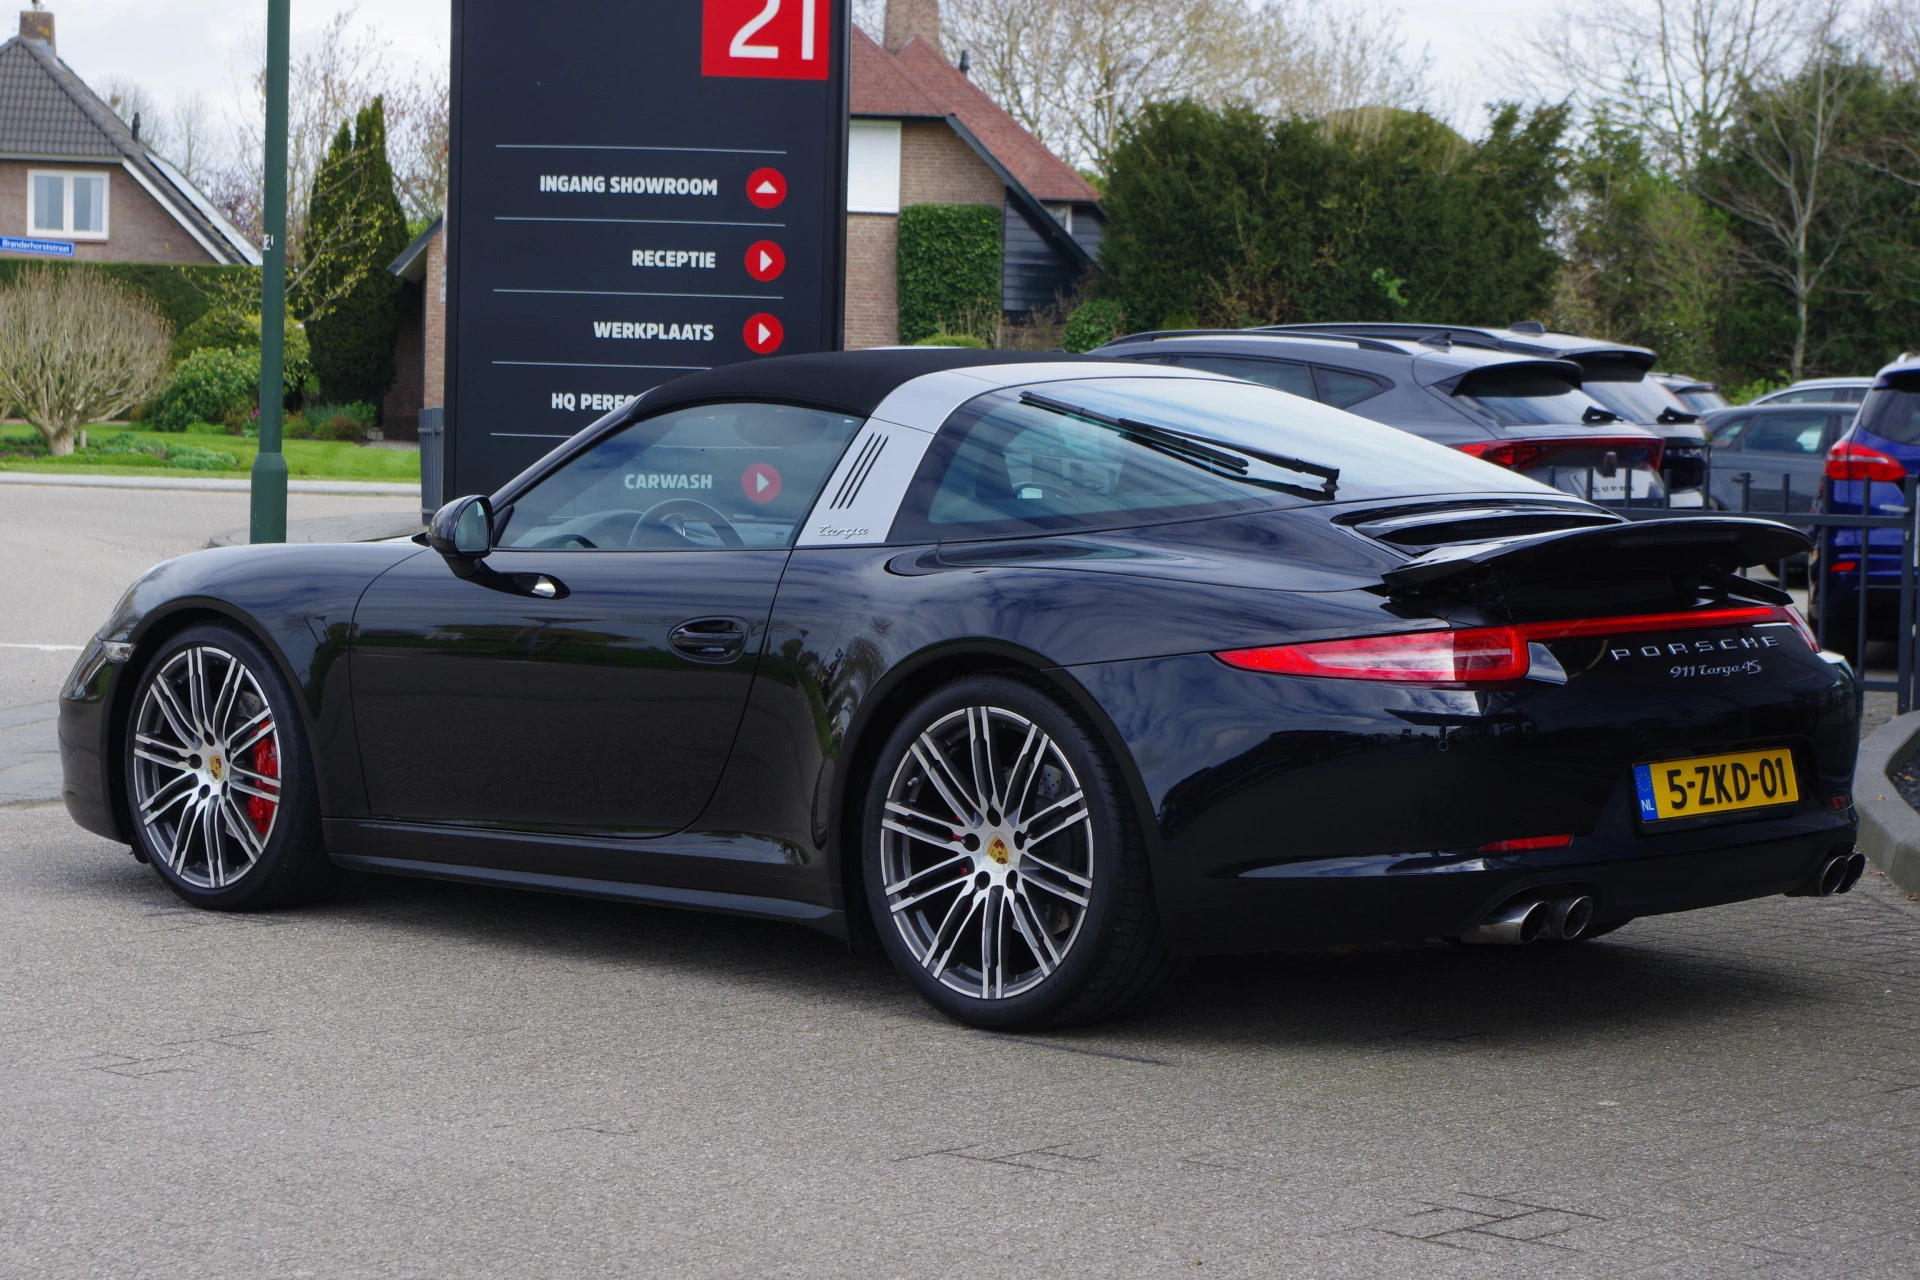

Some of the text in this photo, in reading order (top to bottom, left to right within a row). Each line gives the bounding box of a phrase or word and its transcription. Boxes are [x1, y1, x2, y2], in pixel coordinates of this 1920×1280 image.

[729, 0, 816, 61] 21
[539, 175, 718, 196] INGANG SHOWROOM
[631, 249, 716, 269] RECEPTIE
[593, 321, 714, 341] WERKPLAATS
[551, 392, 576, 412] HQ
[624, 473, 713, 490] CARWASH
[1611, 636, 1779, 661] PORSCHE
[1670, 665, 1696, 677] 911
[1666, 757, 1788, 810] 5-ZKD-01
[1641, 799, 1655, 812] NL
